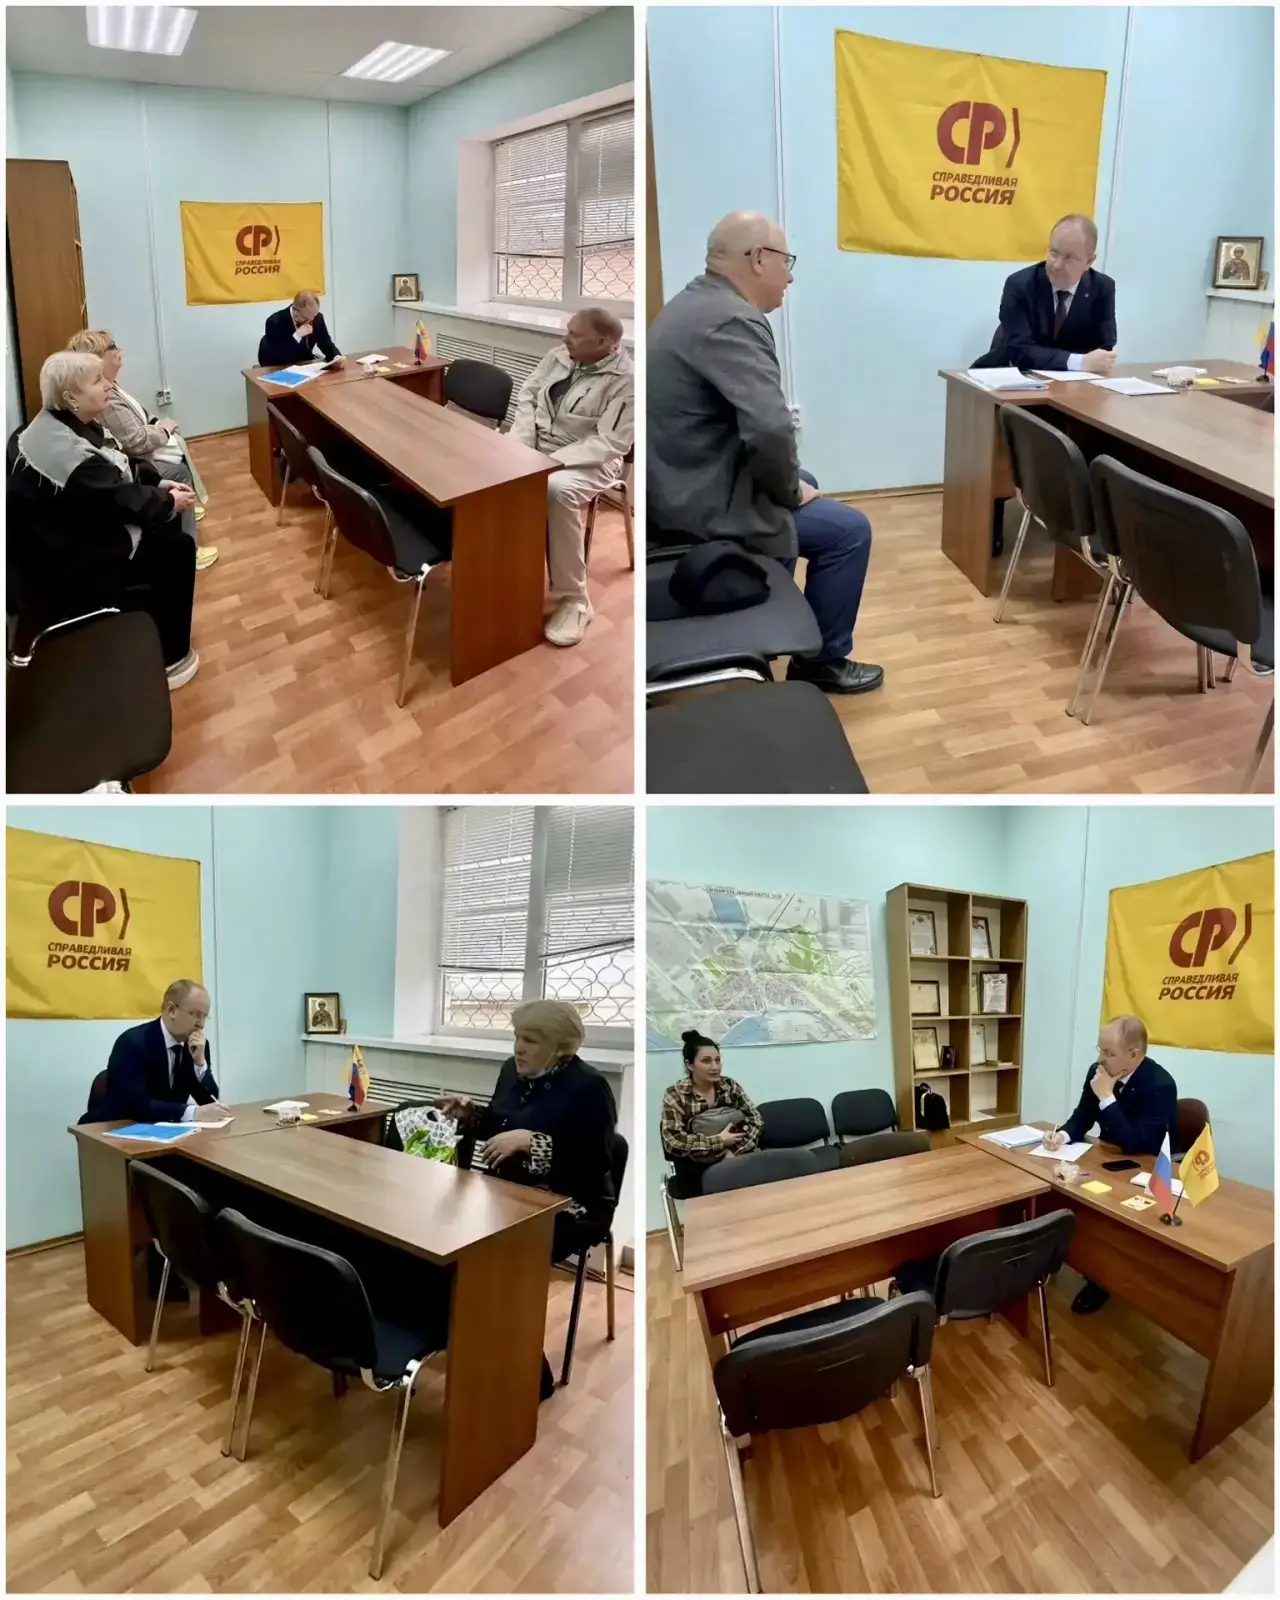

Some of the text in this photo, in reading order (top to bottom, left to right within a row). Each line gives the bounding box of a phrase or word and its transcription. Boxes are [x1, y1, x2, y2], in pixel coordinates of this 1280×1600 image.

[937, 101, 1006, 165] СР
[932, 171, 1018, 188] СПРАВЕДЛИВАЯ
[930, 184, 1015, 205] РОССИЯ
[235, 265, 280, 275] РОССИЯ
[48, 881, 116, 937] СР
[1169, 908, 1237, 968] СР
[47, 942, 132, 957] СПРАВЕДЛИВАЯ
[47, 953, 131, 972] РОССИЯ
[1163, 973, 1239, 986] СПРАВЕДЛИВАЯ
[1158, 985, 1236, 1001] РОССИЯ
